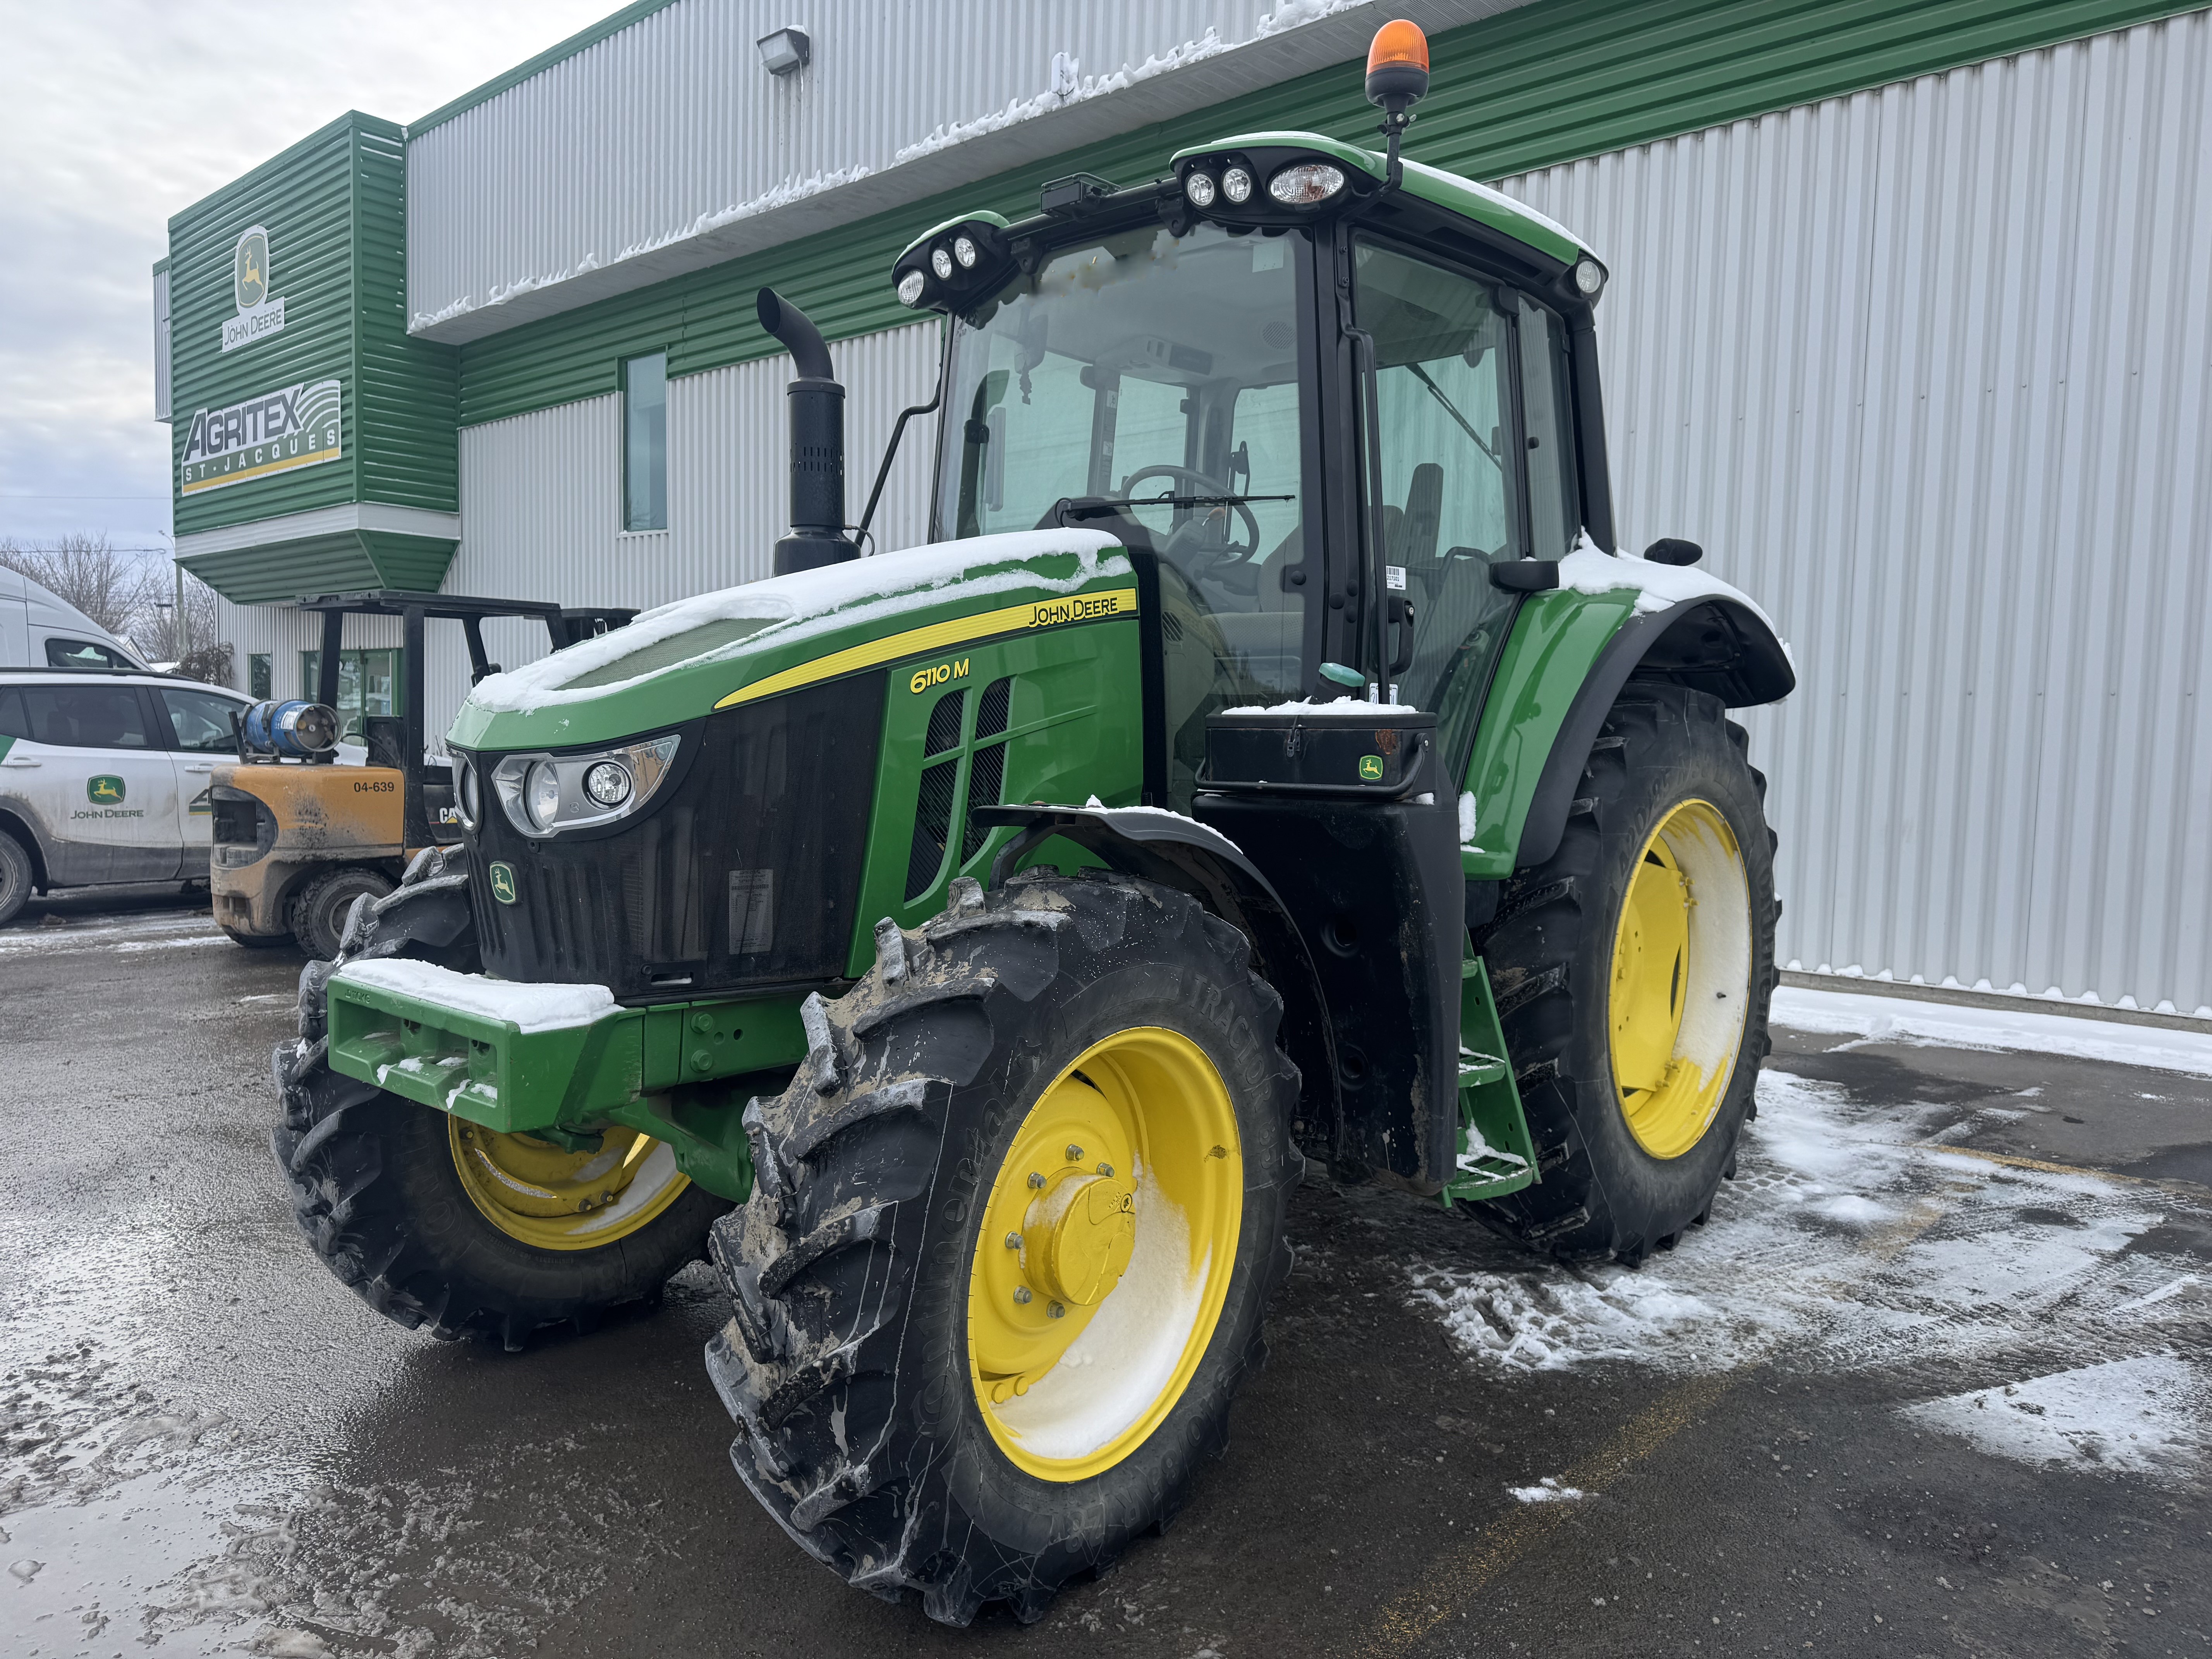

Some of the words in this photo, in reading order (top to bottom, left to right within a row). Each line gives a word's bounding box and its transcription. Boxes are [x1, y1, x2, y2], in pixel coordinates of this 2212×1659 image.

[225, 322, 248, 345] JOHN
[251, 309, 282, 335] DEERE
[184, 388, 301, 460] AGRITEX
[1029, 605, 1070, 626] JOHN
[1073, 597, 1118, 618] DEERE
[910, 664, 951, 694] 6110
[954, 658, 969, 679] M
[354, 782, 395, 793] 04-639
[70, 810, 103, 819] JOHN
[105, 809, 144, 818] DEERE
[439, 807, 458, 824] CA
[1190, 972, 1272, 1112] TRACTOR
[911, 1067, 1023, 1438] Continental
